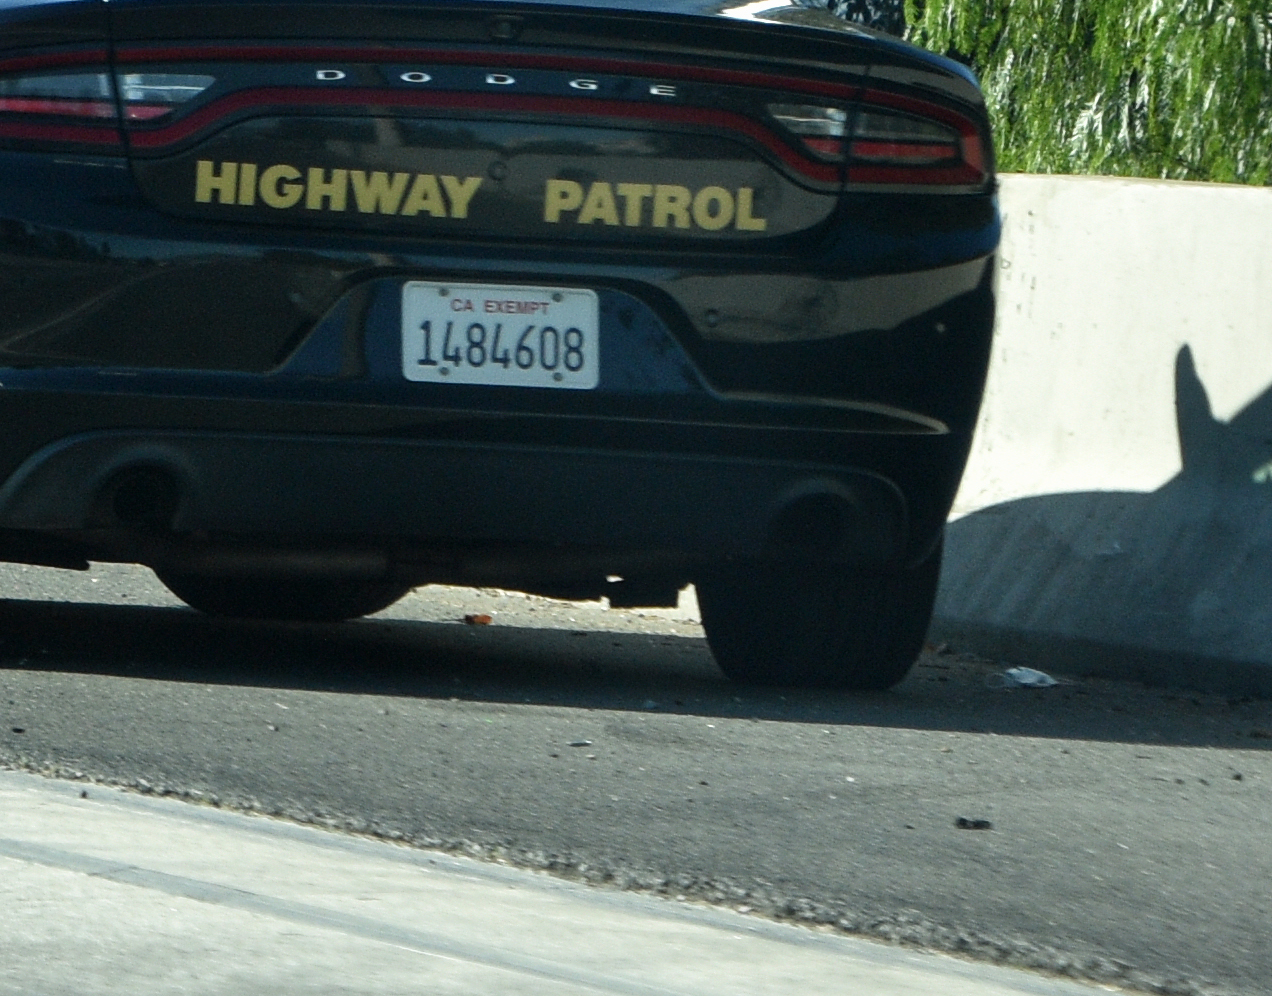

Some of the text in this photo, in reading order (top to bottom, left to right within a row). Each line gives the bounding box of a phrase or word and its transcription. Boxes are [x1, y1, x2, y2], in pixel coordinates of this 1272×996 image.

[315, 68, 677, 97] DODGE
[194, 160, 768, 233] HIGHWAY PATROL
[450, 298, 551, 315] CA EXEMPT
[417, 319, 584, 373] 1484608
